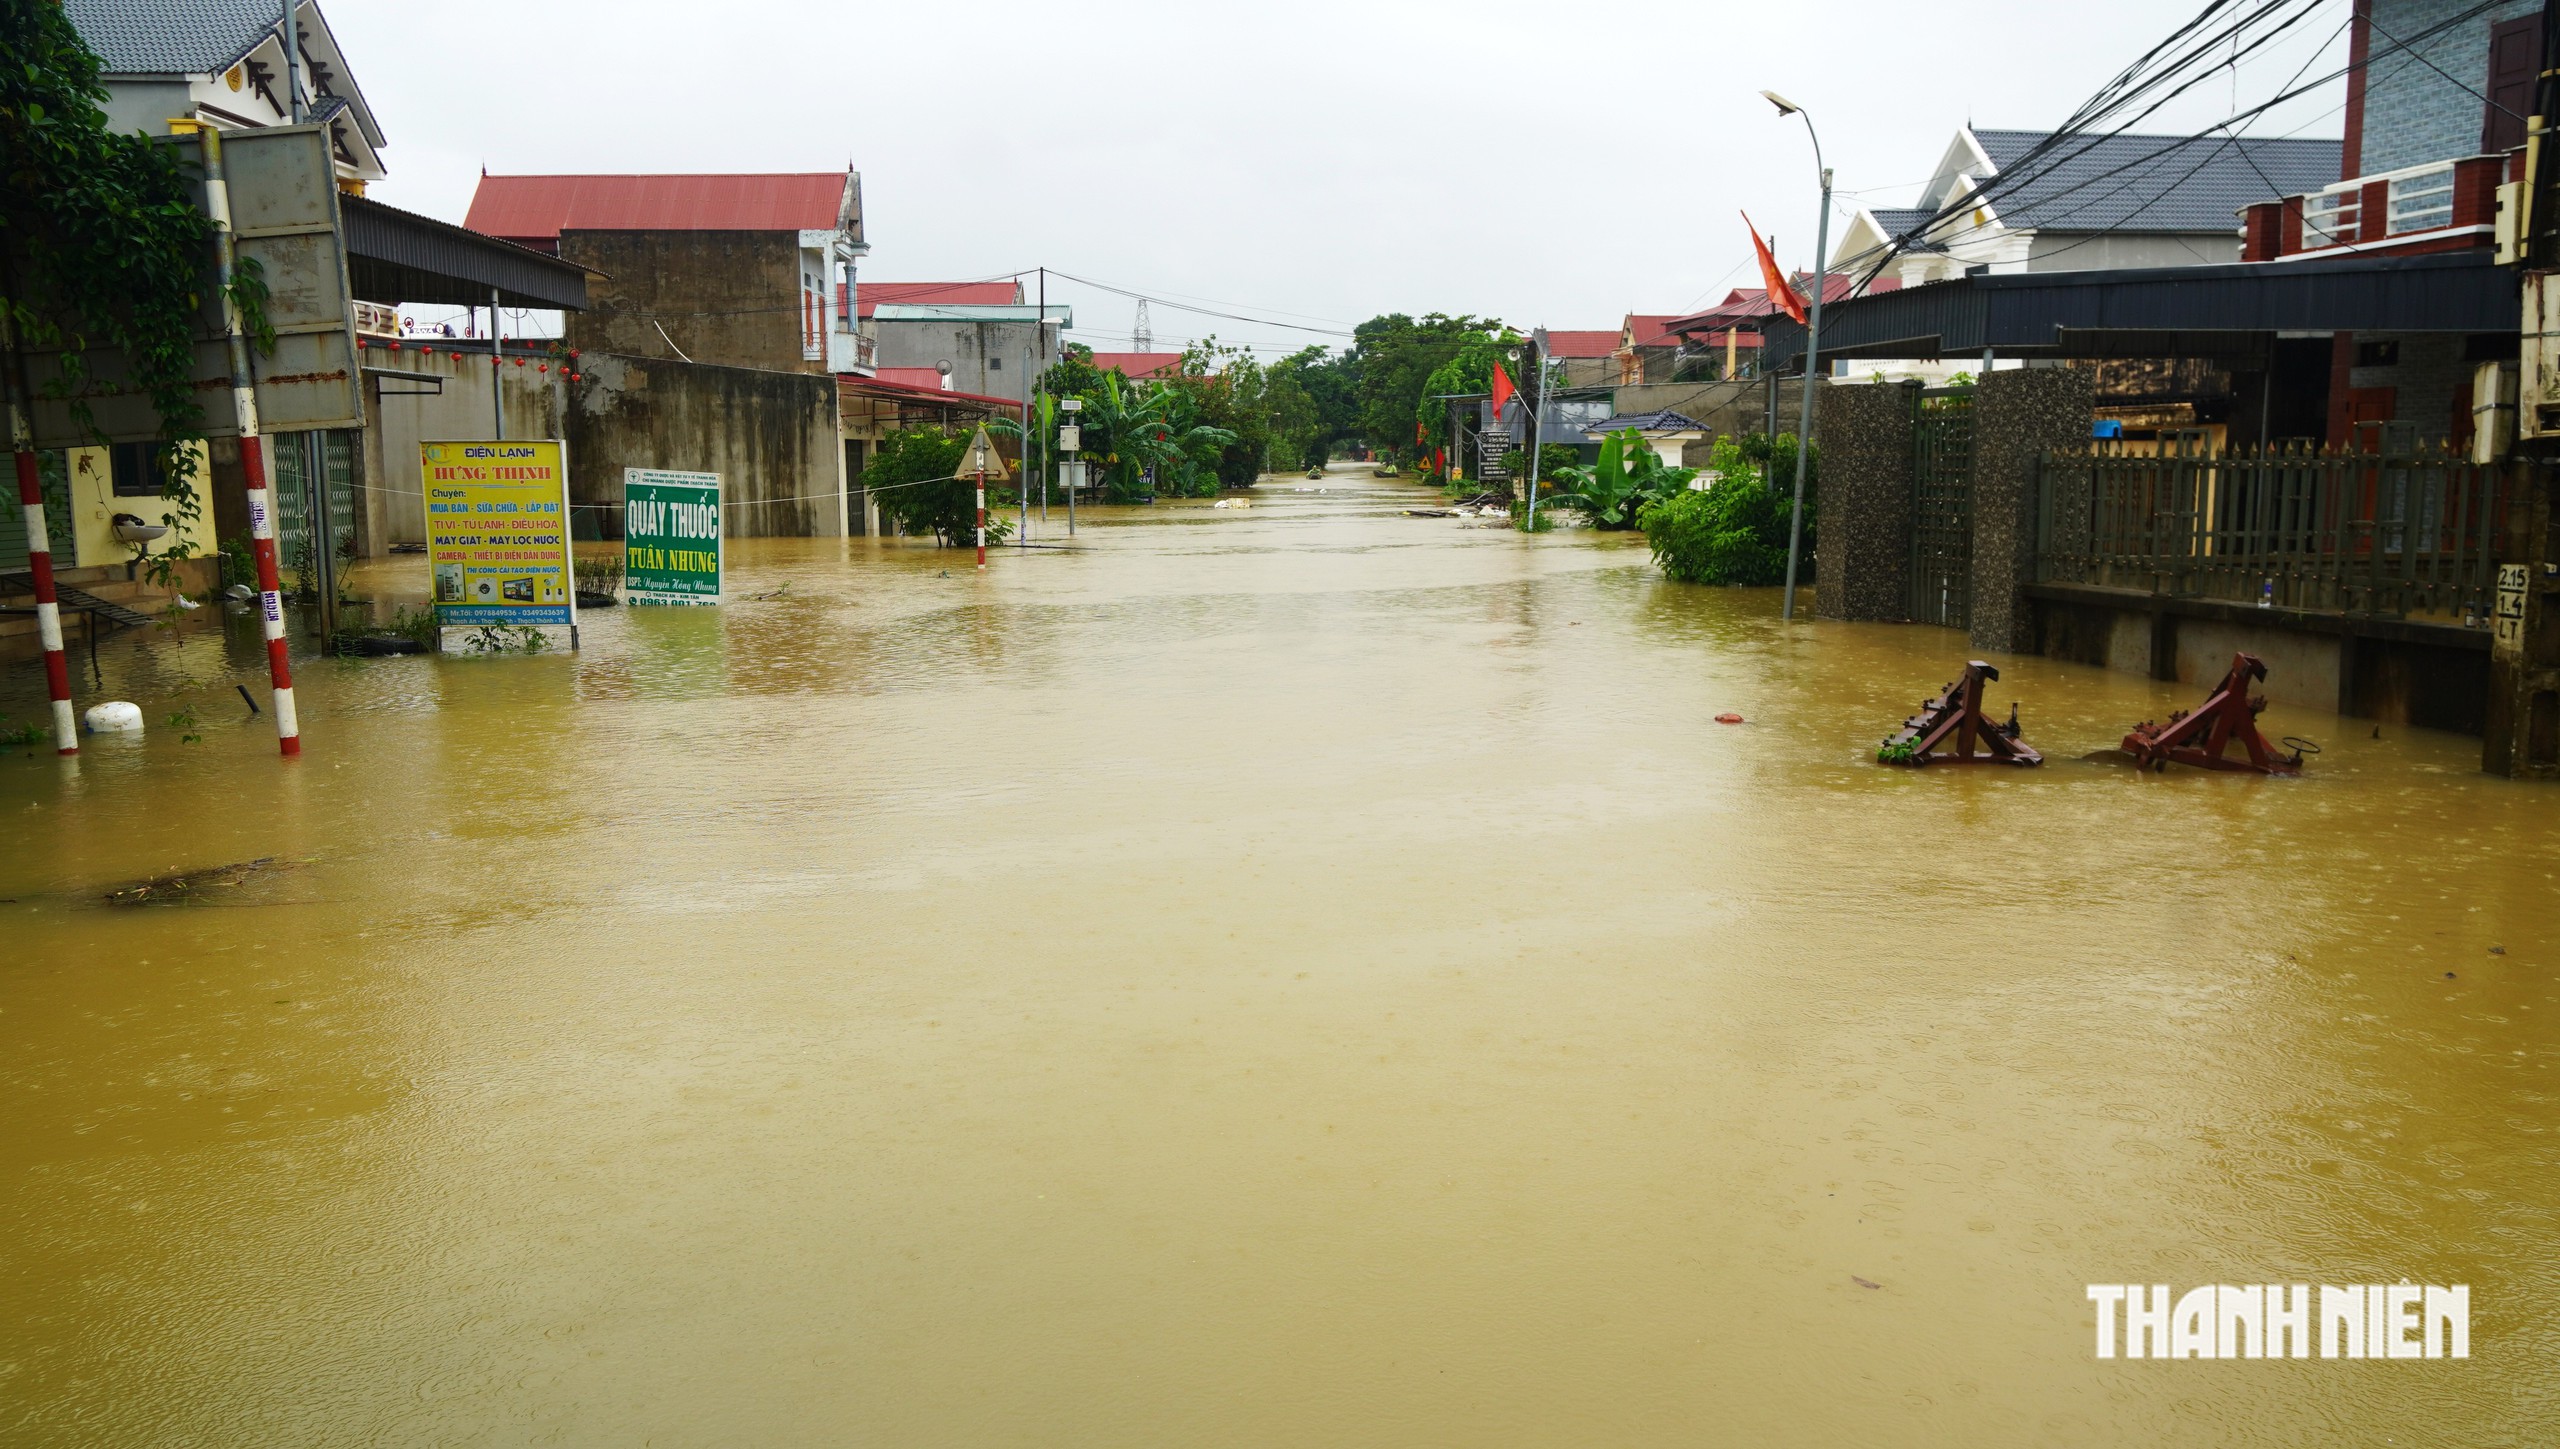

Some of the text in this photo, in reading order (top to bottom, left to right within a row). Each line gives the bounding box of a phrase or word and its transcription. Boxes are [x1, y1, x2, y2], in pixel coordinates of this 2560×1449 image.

[465, 446, 535, 460] ĐIỆN LẠNH
[434, 465, 551, 484] HƯNG THỊNH
[431, 489, 466, 499] Chuyên:
[430, 503, 449, 513] MUA
[451, 501, 469, 513] BÁN
[628, 488, 718, 540] QUẦY THUỐC
[433, 520, 444, 529] TI
[445, 520, 456, 529] VI
[478, 520, 505, 531] LẠNH
[513, 536, 532, 546] LỌC
[436, 552, 467, 560] CAMERA
[504, 550, 521, 561] ĐIỆN
[541, 552, 560, 561] DỤNG
[669, 549, 717, 573] NHUNG
[2499, 568, 2526, 587] 2.15
[693, 579, 717, 593] Nhung
[2499, 594, 2522, 615] 1.4
[474, 609, 517, 617] 0978849536
[522, 609, 565, 617] 0349343639
